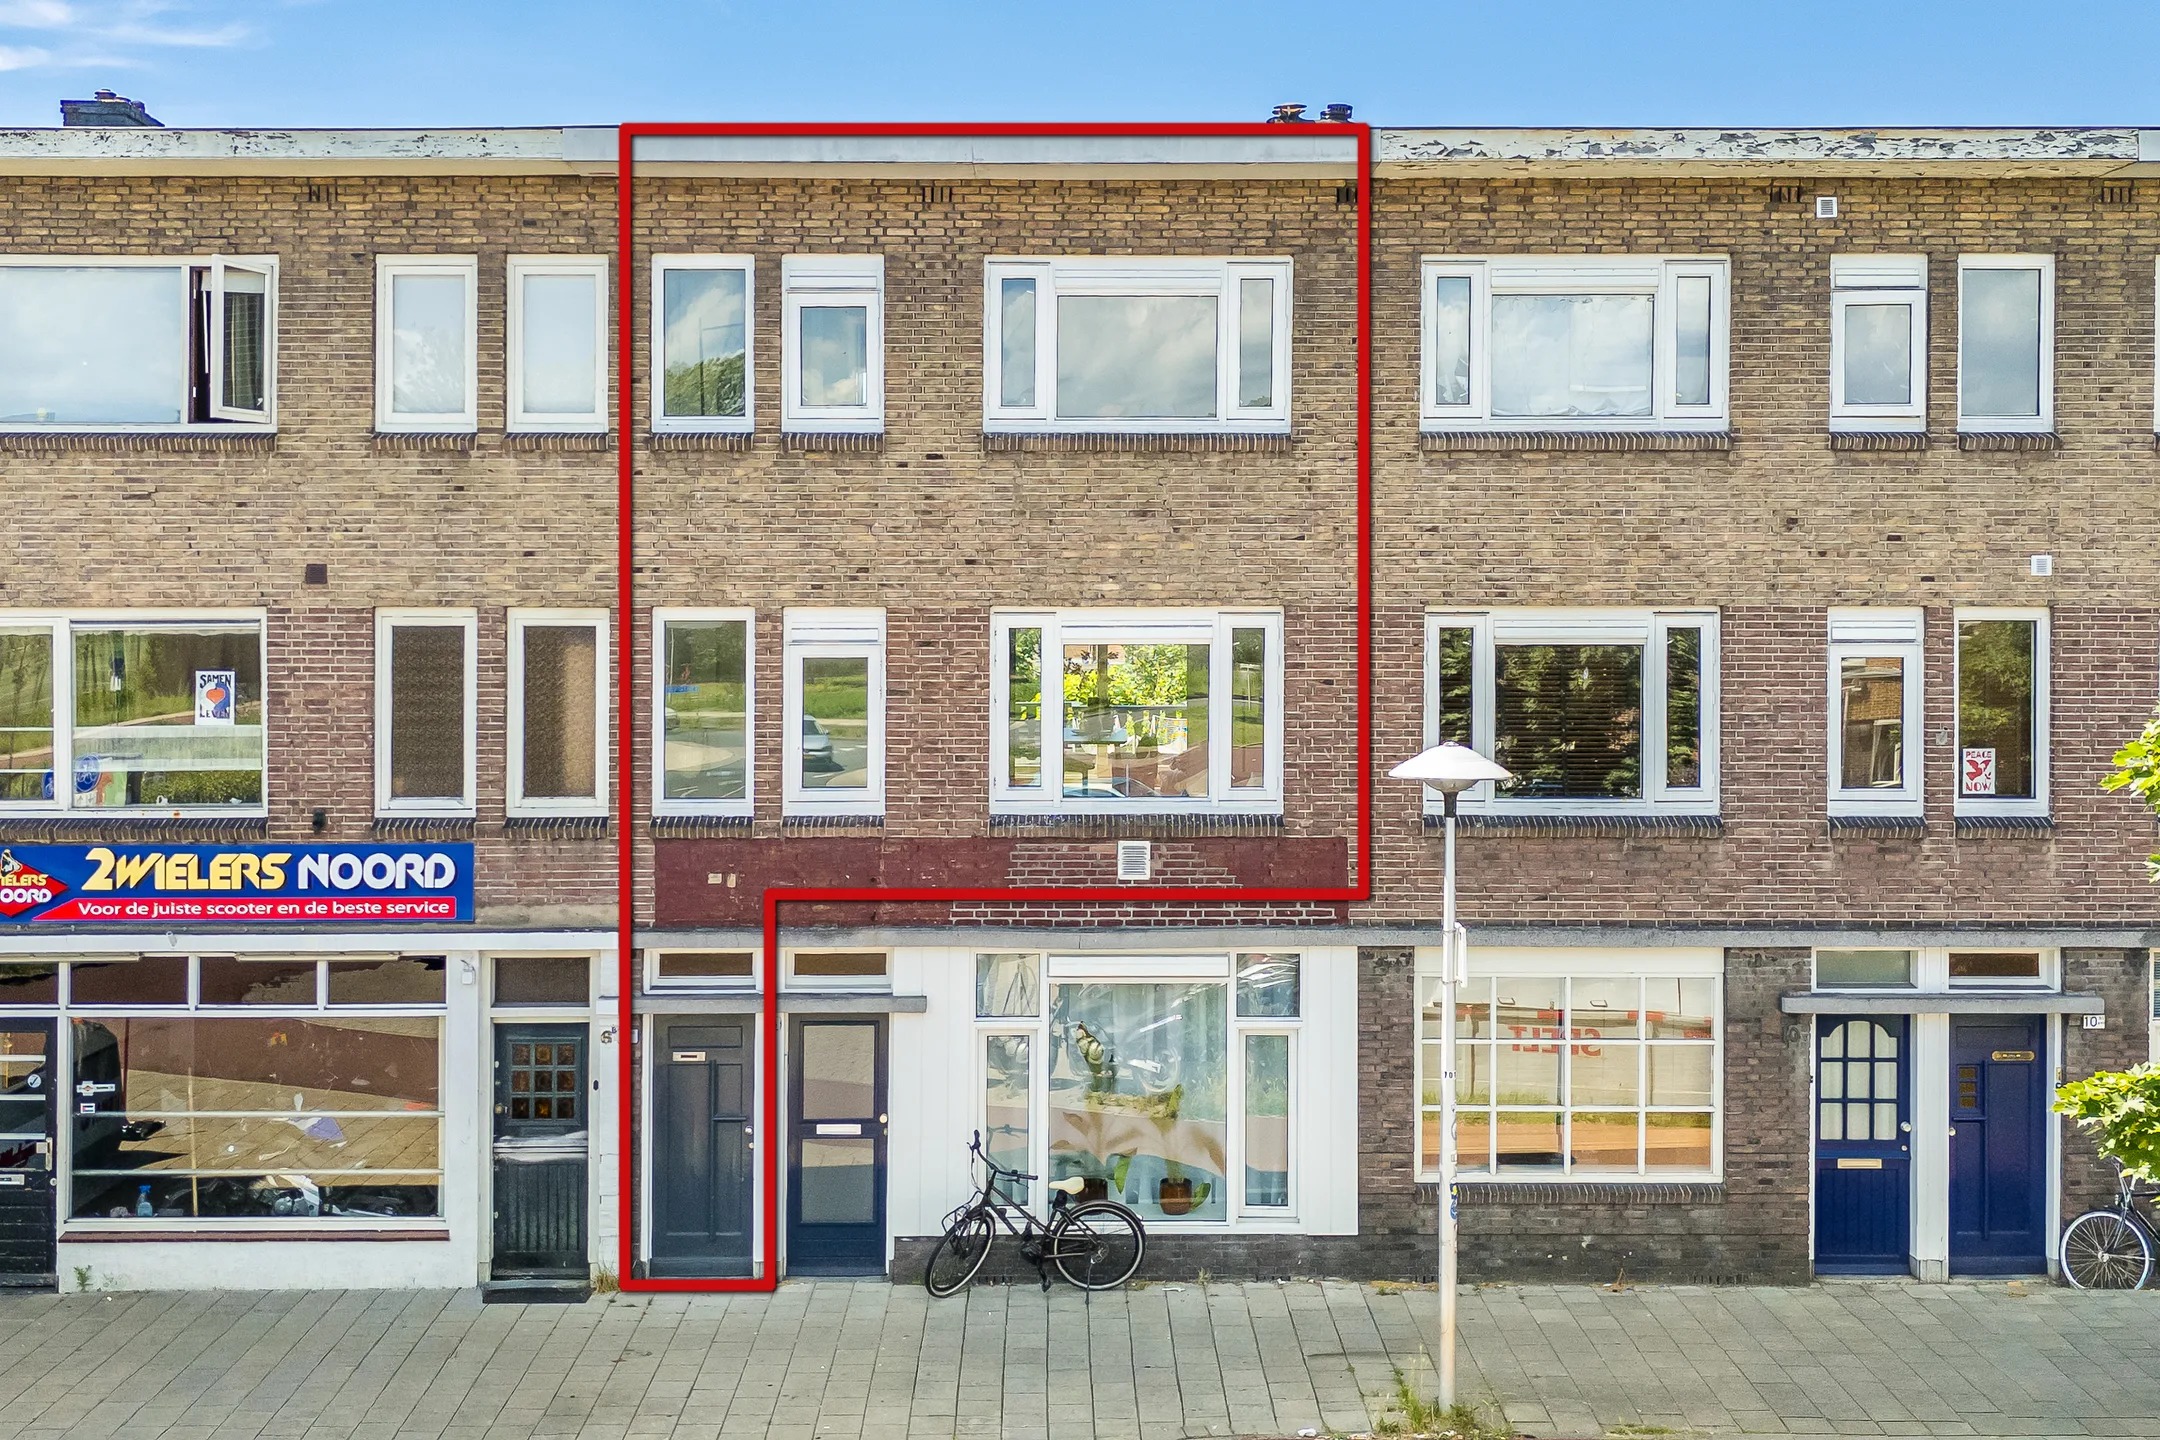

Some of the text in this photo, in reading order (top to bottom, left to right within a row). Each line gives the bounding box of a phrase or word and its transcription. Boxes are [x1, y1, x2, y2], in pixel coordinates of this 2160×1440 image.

[200, 674, 232, 689] SAMEN
[199, 703, 231, 719] LEVEN
[1965, 750, 1992, 759] PEACE
[1965, 781, 1992, 792] NOW
[81, 847, 456, 891] 2WIELERS NOORD
[0, 888, 53, 903] OORD
[78, 901, 449, 918] Voor de juiste scooter en de beste service
[2084, 1016, 2098, 1027] 10
